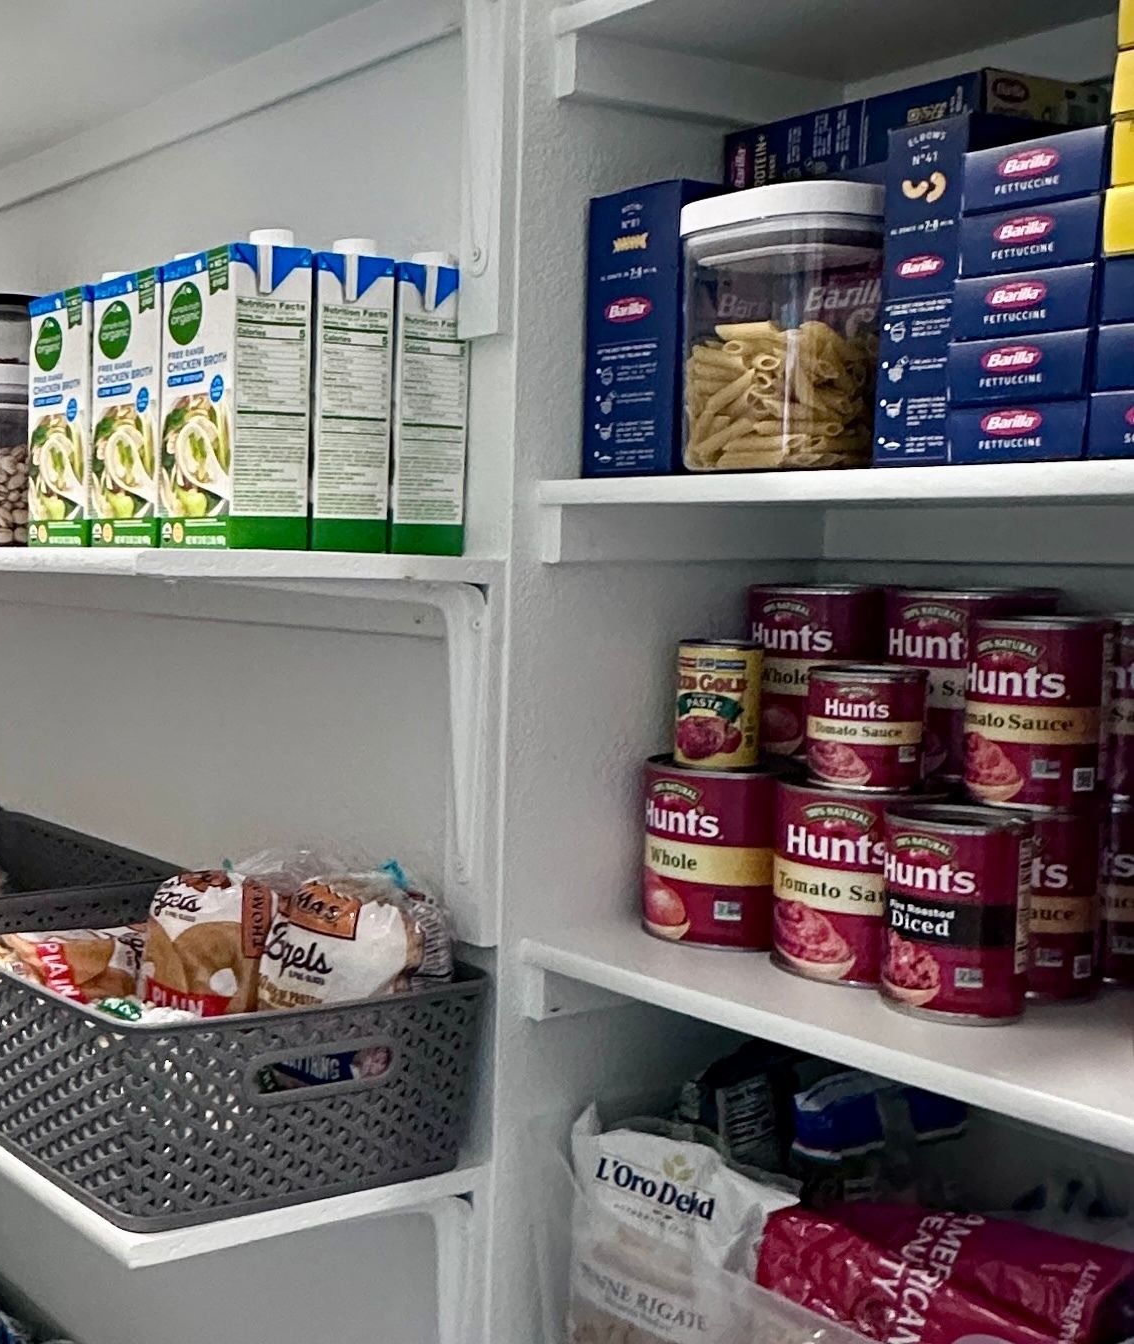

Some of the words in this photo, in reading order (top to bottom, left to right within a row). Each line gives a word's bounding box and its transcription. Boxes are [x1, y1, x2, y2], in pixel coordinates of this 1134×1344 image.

[753, 133, 768, 187] ROTEIN+
[1002, 151, 1056, 176] Barilla
[993, 174, 1061, 197] FETTUCCINE
[999, 218, 1050, 242] Barilla
[991, 241, 1056, 261] FETTUCCINE
[900, 259, 939, 276] Barilla
[804, 277, 882, 314] Barill
[991, 285, 1043, 307] Barilla
[983, 308, 1047, 325] FETTUCCINE
[167, 358, 202, 373] CHICKEN
[203, 352, 228, 367] BROTH
[986, 349, 1039, 369] Barilla
[97, 371, 130, 385] CHICKEN
[979, 372, 1043, 389] FETTUCCINE
[986, 413, 1038, 432] Barilla
[978, 436, 1043, 451] FETTUCCINE
[699, 673, 748, 693] GOLD
[686, 696, 723, 712] PASTE
[861, 724, 903, 739] Sauce
[1008, 713, 1074, 733] Sauce
[826, 806, 870, 825] NATURAL
[650, 846, 698, 872] Whole
[778, 870, 841, 899] Tomato
[907, 902, 956, 920] Roasted
[1029, 908, 1075, 922] auce
[890, 910, 951, 937] Diced
[40, 942, 82, 1002] PLAIN
[150, 986, 204, 1015] PLAIN
[595, 1156, 657, 1198] L'Oro
[870, 1213, 955, 1299] EAUTY
[636, 1291, 709, 1333] RIGATE
